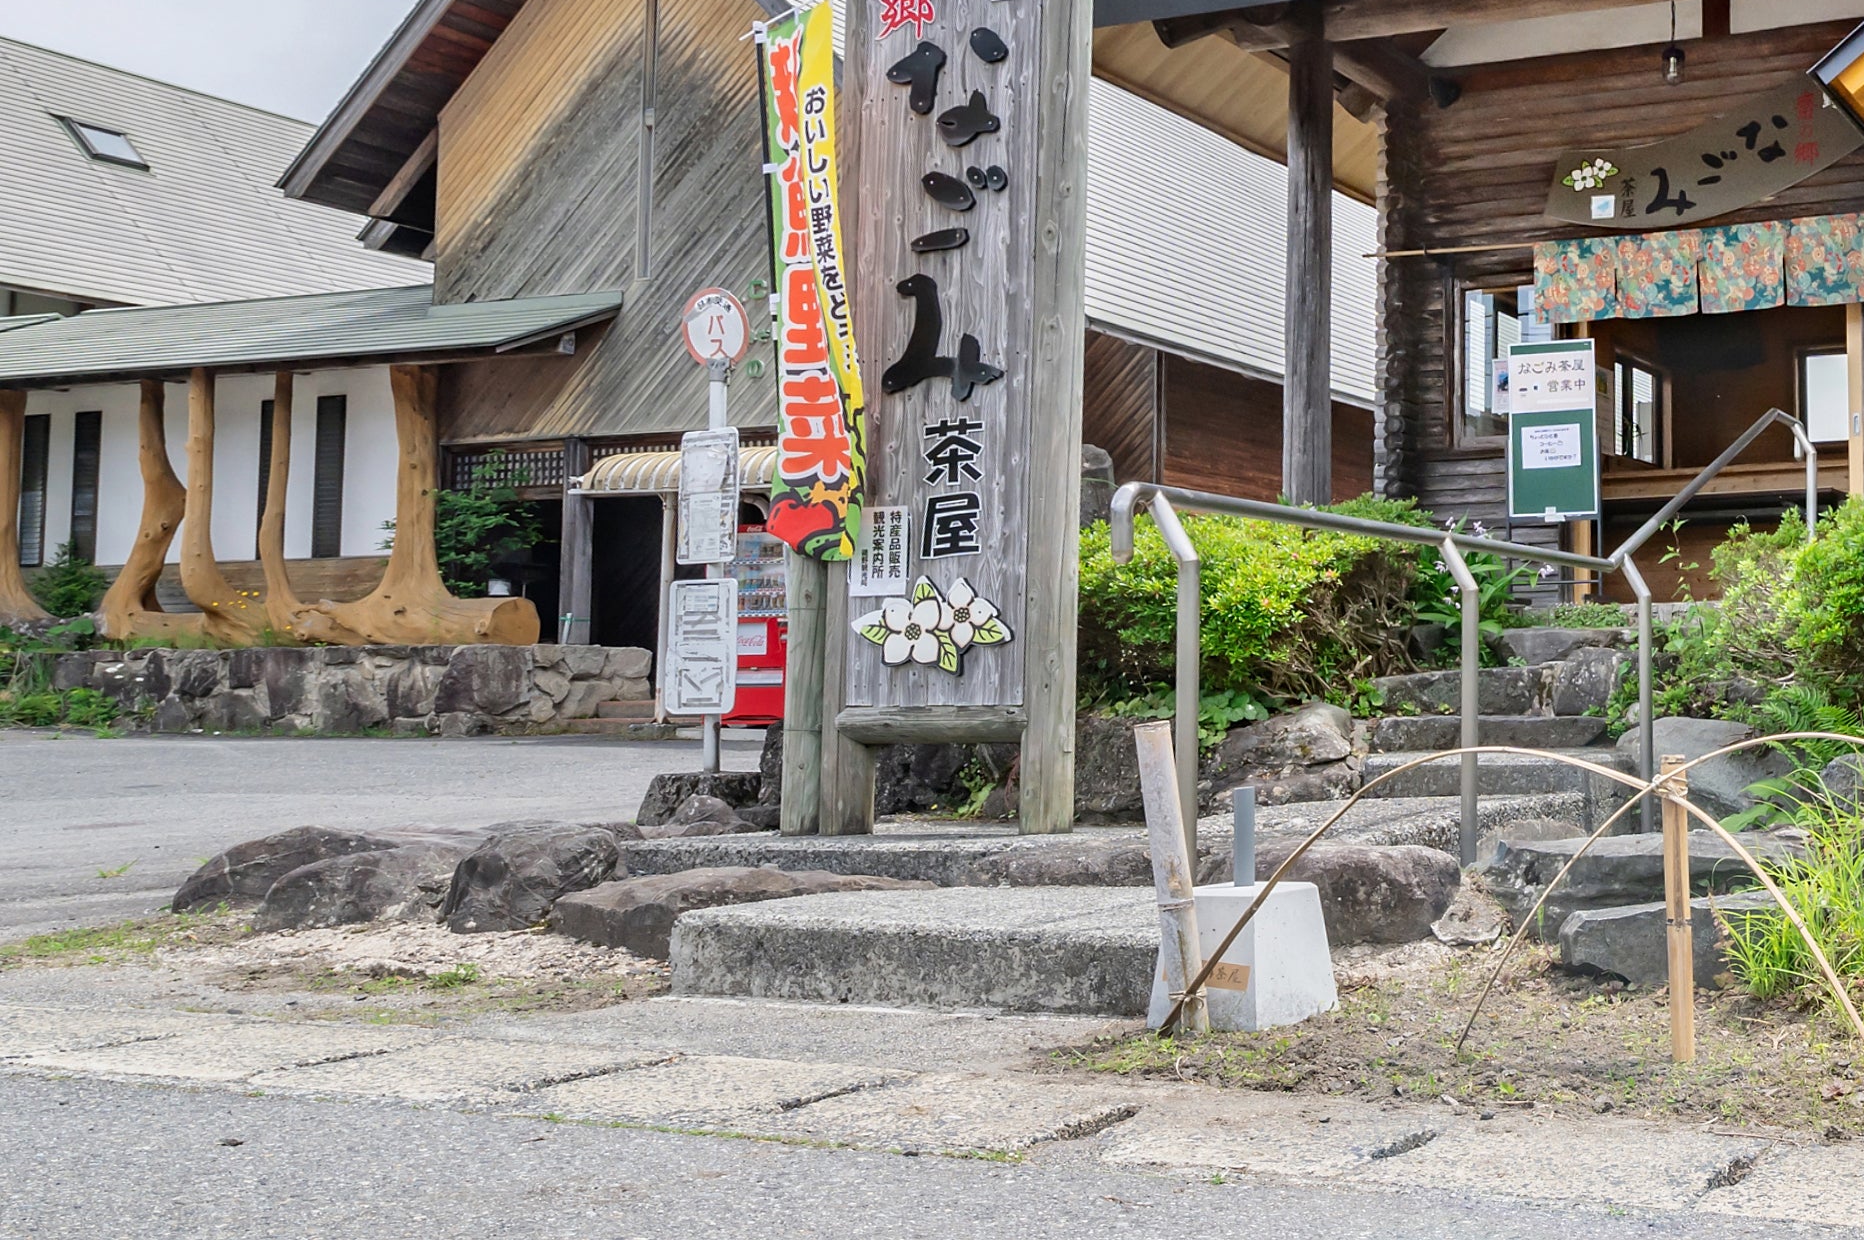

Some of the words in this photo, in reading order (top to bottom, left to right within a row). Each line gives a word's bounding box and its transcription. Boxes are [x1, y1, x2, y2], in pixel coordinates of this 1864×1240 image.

[1619, 177, 1637, 219] 茶屋
[707, 315, 728, 358] バス
[1518, 359, 1585, 375] なごみ茶屋
[1547, 378, 1586, 393] 営業中
[921, 416, 985, 559] 茶屋
[871, 511, 885, 579] 観光案内所
[888, 510, 902, 579] 特産品販売
